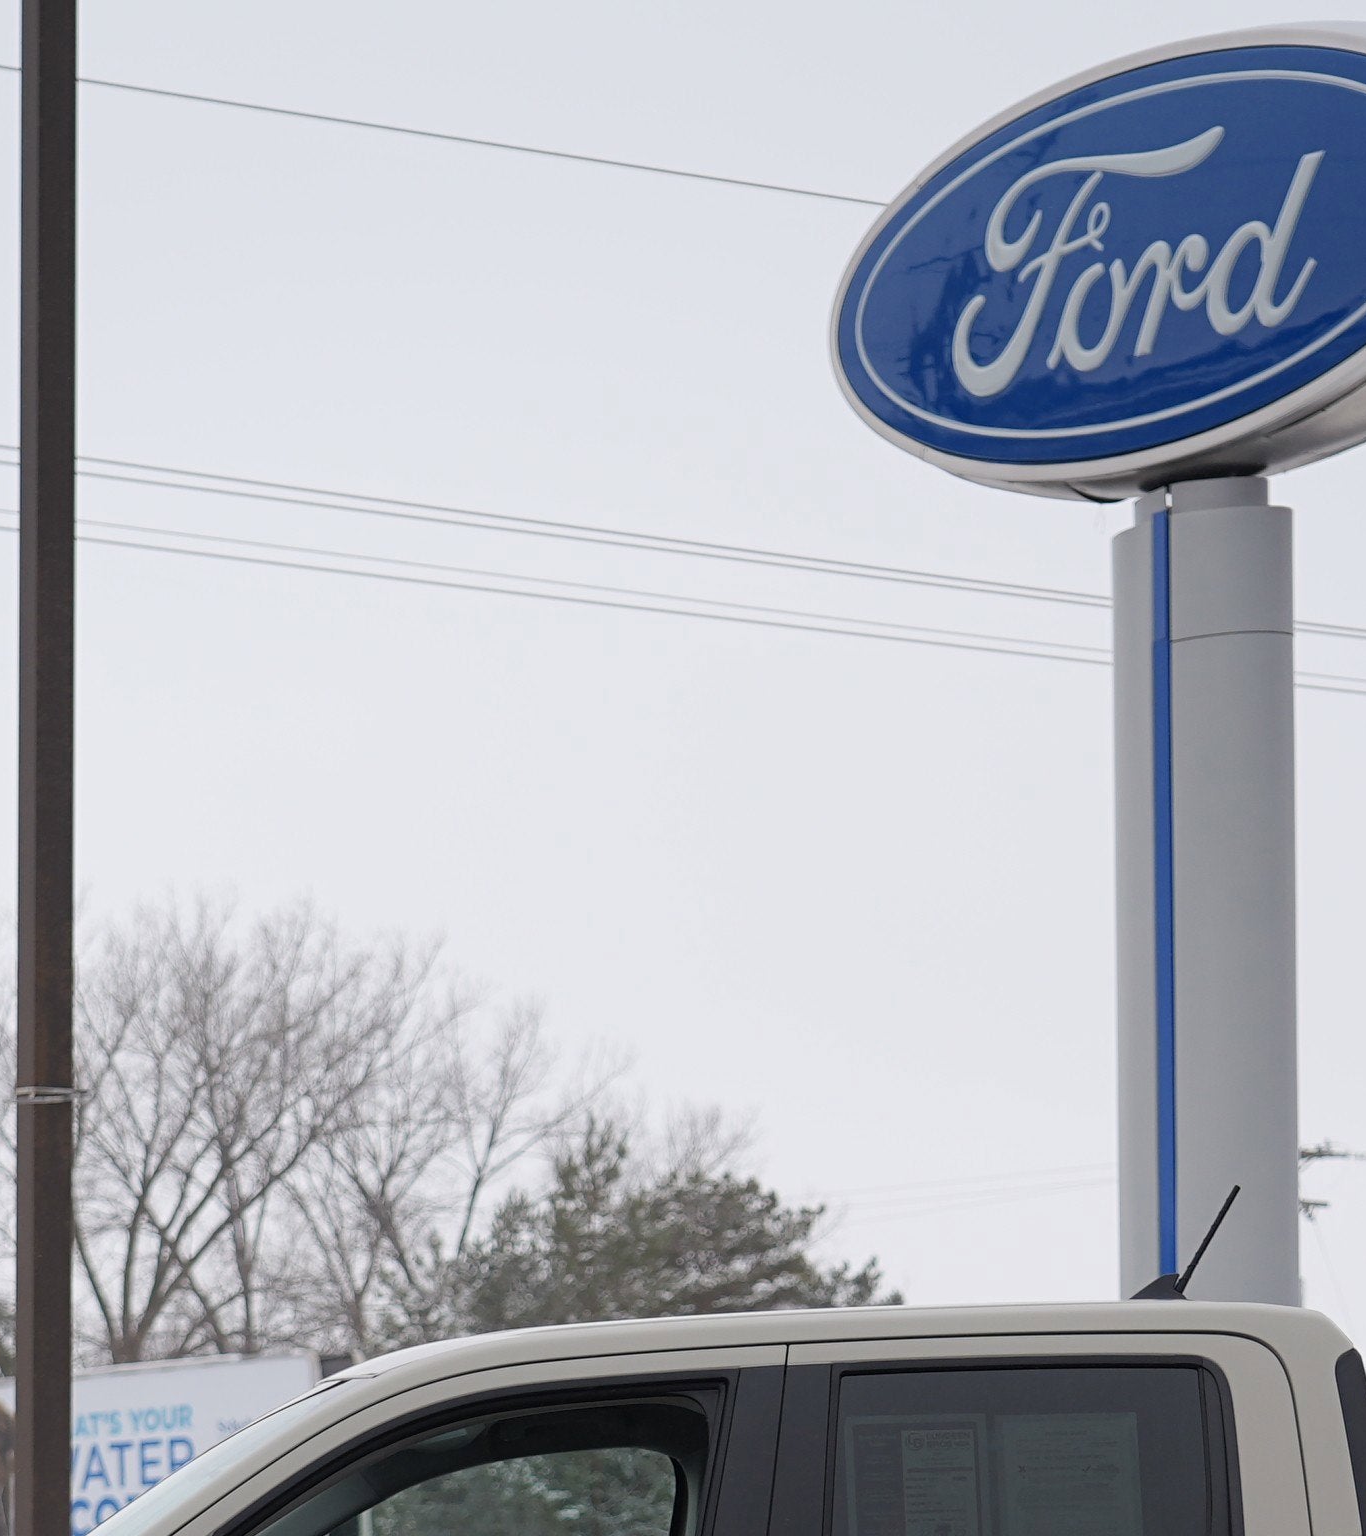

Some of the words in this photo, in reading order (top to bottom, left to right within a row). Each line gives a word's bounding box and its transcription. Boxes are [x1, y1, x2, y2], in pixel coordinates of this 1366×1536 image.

[952, 125, 1325, 397] Ford
[130, 1404, 193, 1432] YOUR
[72, 1437, 193, 1490] ATER
